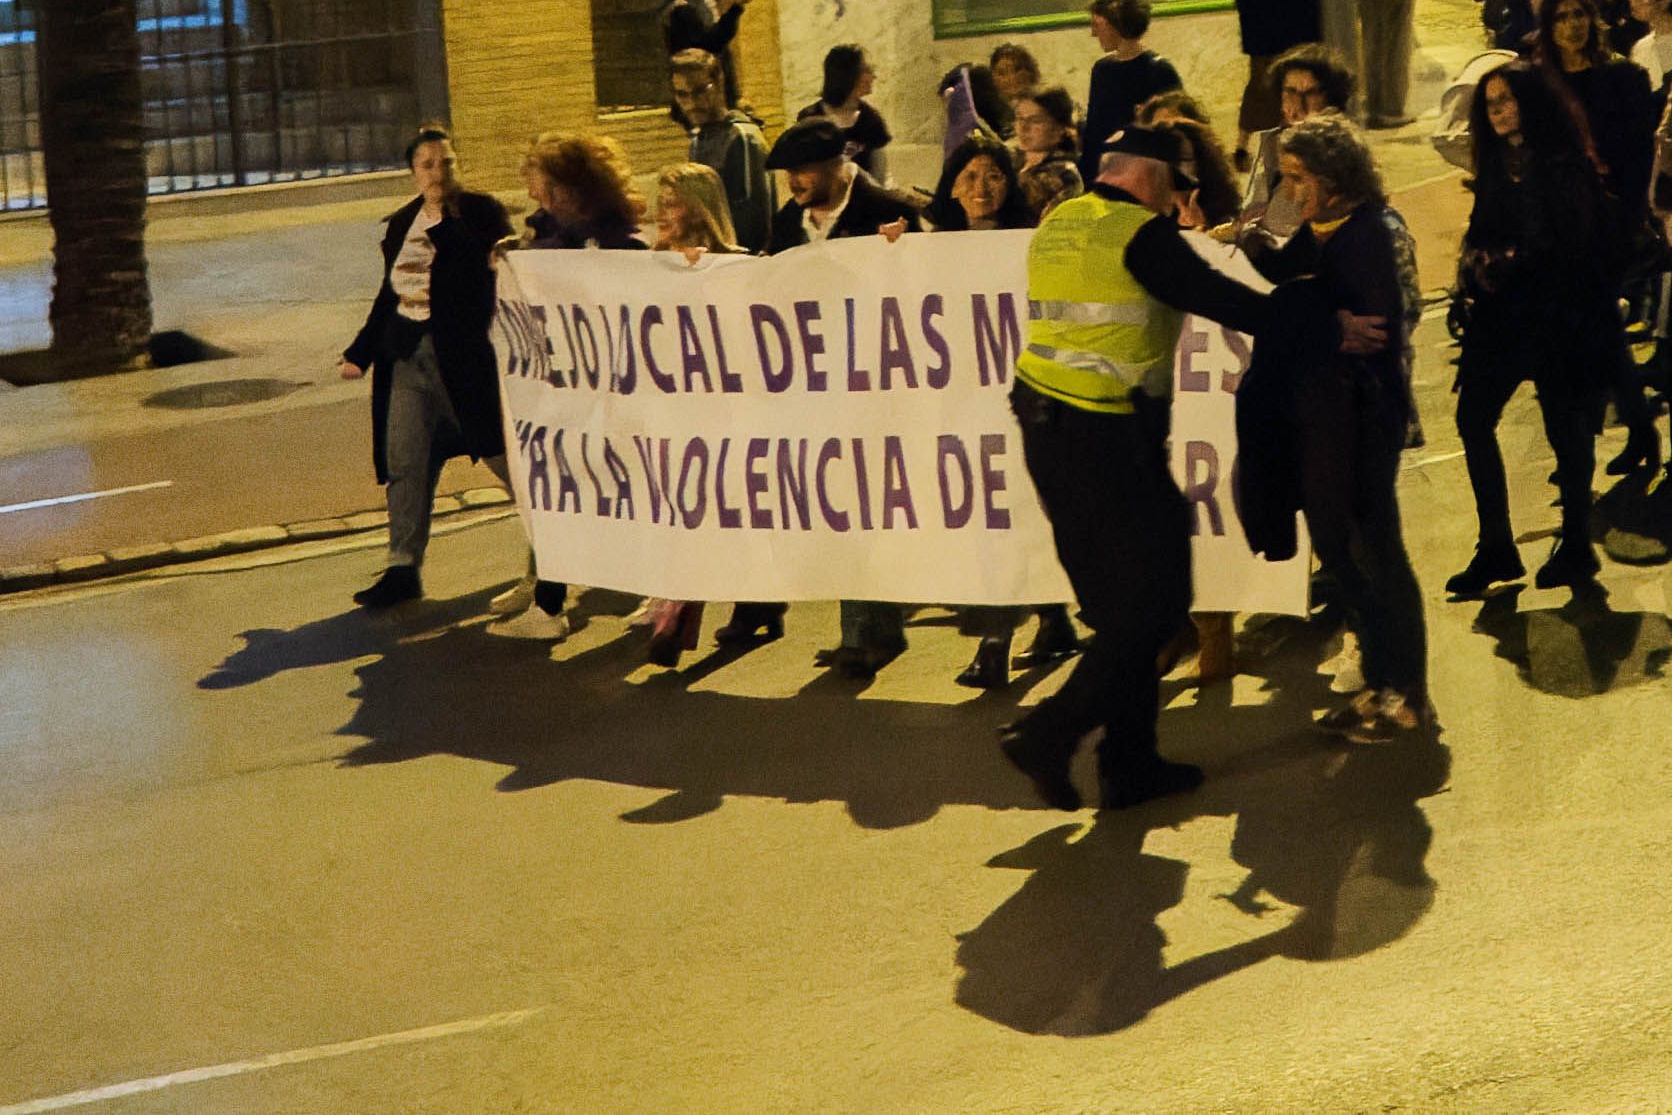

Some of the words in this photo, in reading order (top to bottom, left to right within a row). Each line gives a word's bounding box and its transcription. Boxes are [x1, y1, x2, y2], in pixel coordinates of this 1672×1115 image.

[748, 300, 828, 393] DE
[843, 293, 953, 392] LAS
[581, 431, 635, 521] LA
[632, 434, 918, 533] VIOLENCIA
[936, 433, 1012, 530] DE
